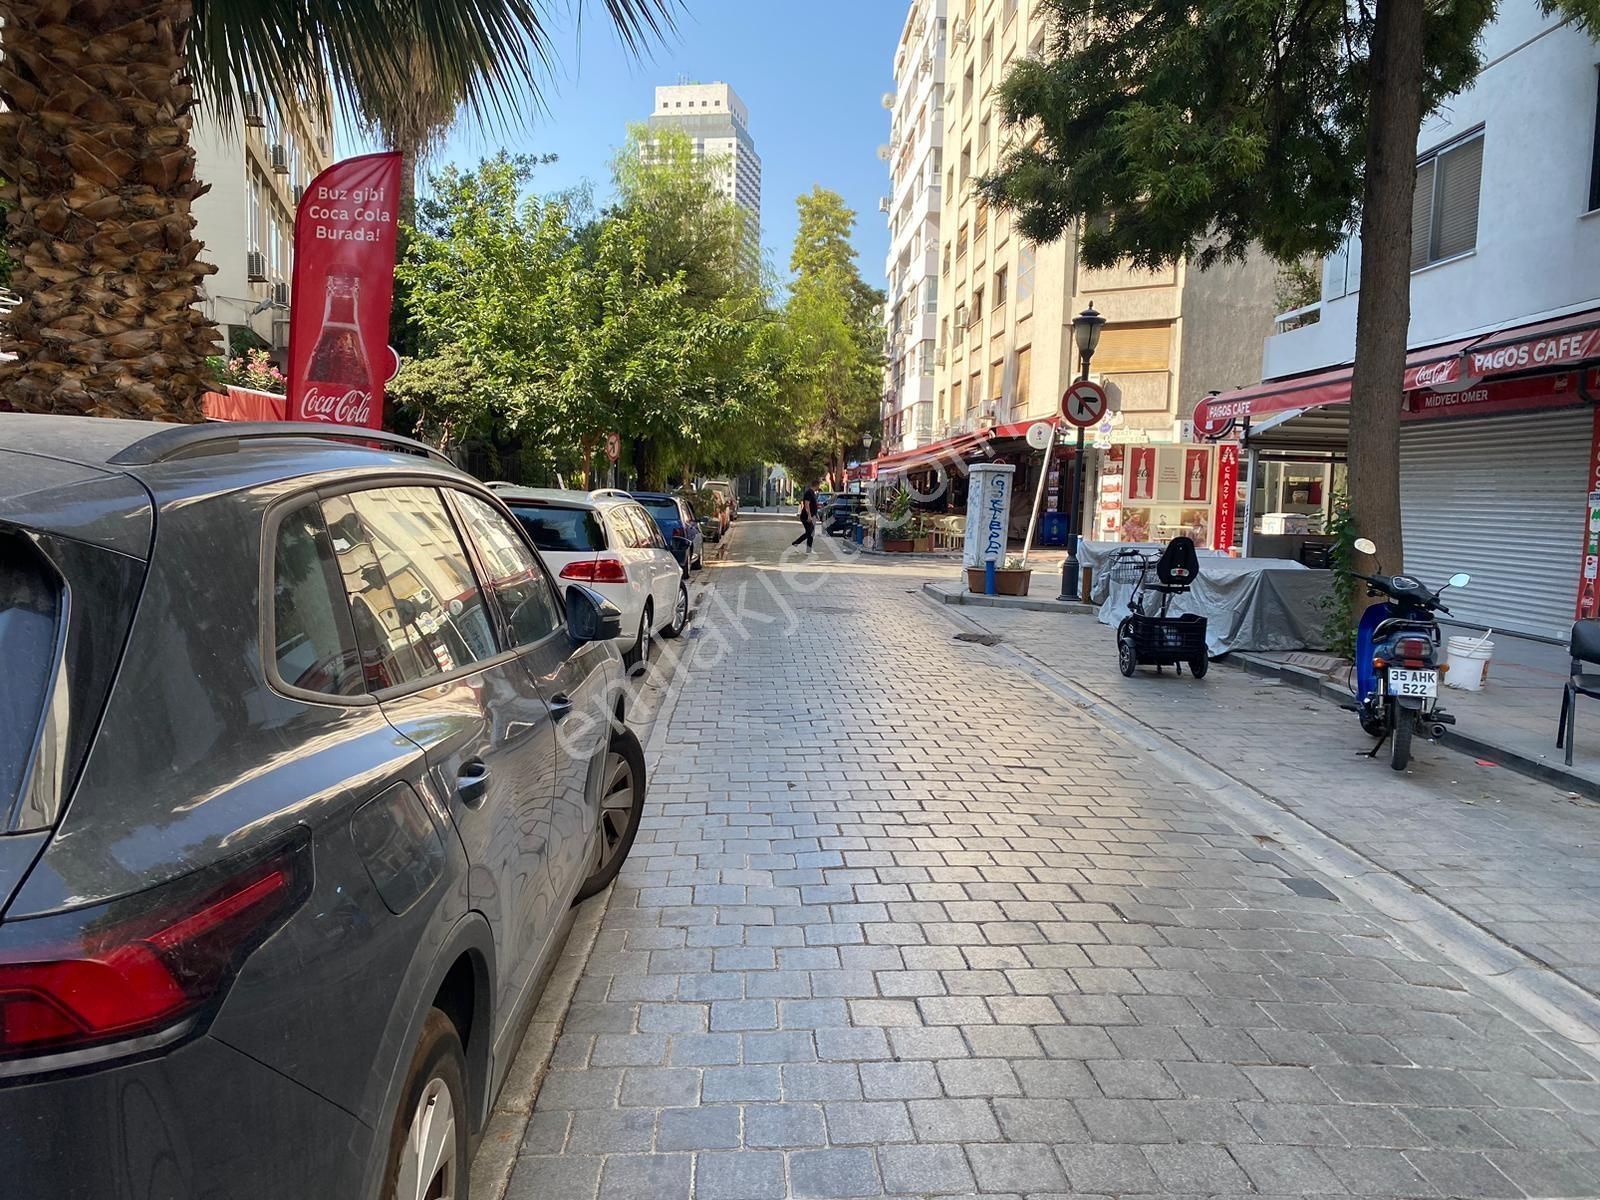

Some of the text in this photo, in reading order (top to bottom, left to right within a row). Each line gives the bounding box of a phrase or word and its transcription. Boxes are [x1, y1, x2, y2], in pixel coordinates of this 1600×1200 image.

[318, 187, 384, 204] Buz gibi
[309, 206, 390, 222] Coca Cola
[316, 225, 380, 241] Burada!
[1473, 335, 1583, 372] PAGOS CAFE
[1209, 401, 1251, 418] PAGOS CAFE
[1220, 466, 1231, 549] CRAZY CHICKEN
[1391, 671, 1435, 683] 35 AHK
[1403, 684, 1427, 695] 522
